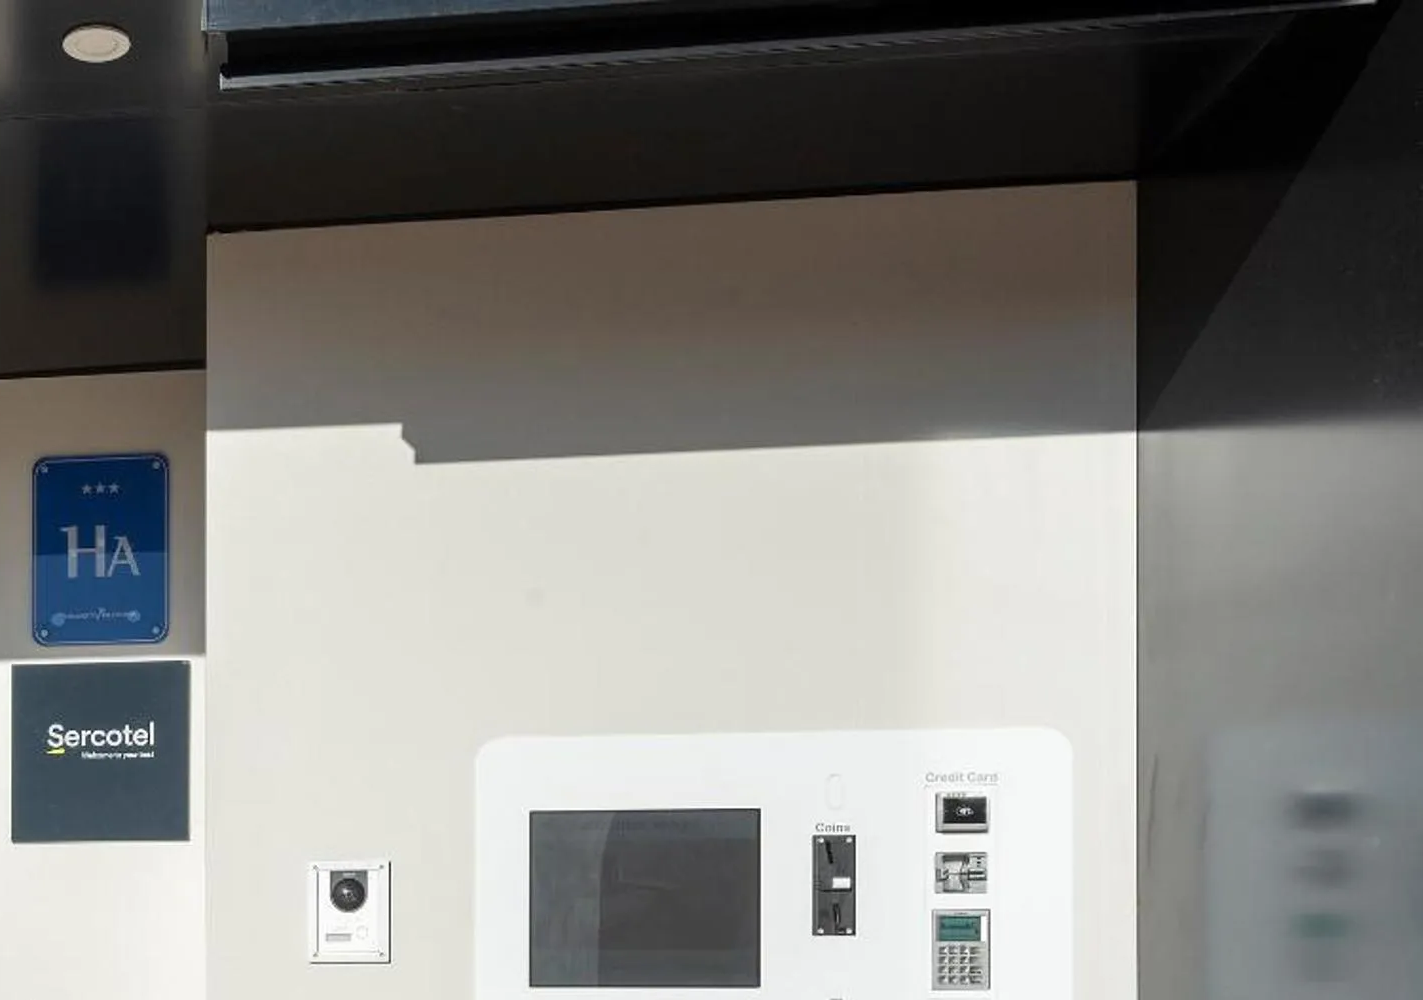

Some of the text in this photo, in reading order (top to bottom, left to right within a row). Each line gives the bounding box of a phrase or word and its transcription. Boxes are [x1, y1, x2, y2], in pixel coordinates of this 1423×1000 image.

[46, 720, 155, 748] Sercotel
[925, 771, 964, 783] Credit
[815, 822, 851, 833] Coins
